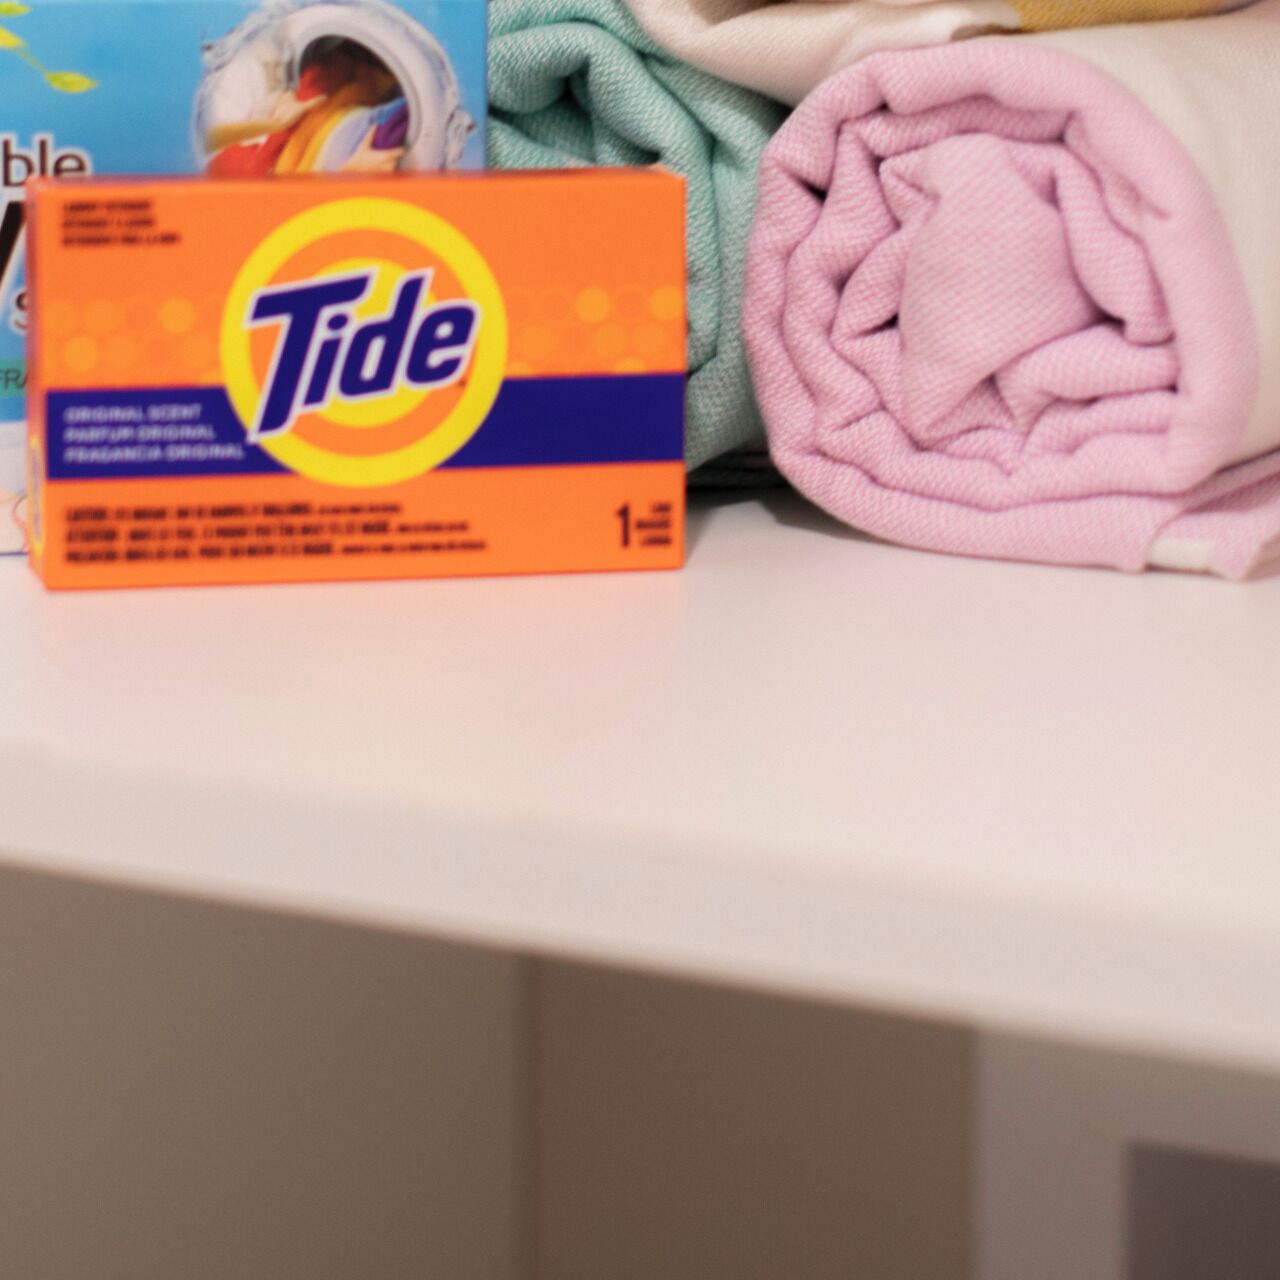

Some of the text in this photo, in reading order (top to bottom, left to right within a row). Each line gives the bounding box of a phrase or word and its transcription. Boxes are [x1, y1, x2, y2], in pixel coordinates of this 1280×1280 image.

[247, 270, 478, 438] Tide
[63, 403, 202, 424] ORIGINAL SCENT
[137, 424, 217, 442] ORIGINAL
[165, 443, 247, 462] ORIGINAL
[615, 502, 630, 549] 1
